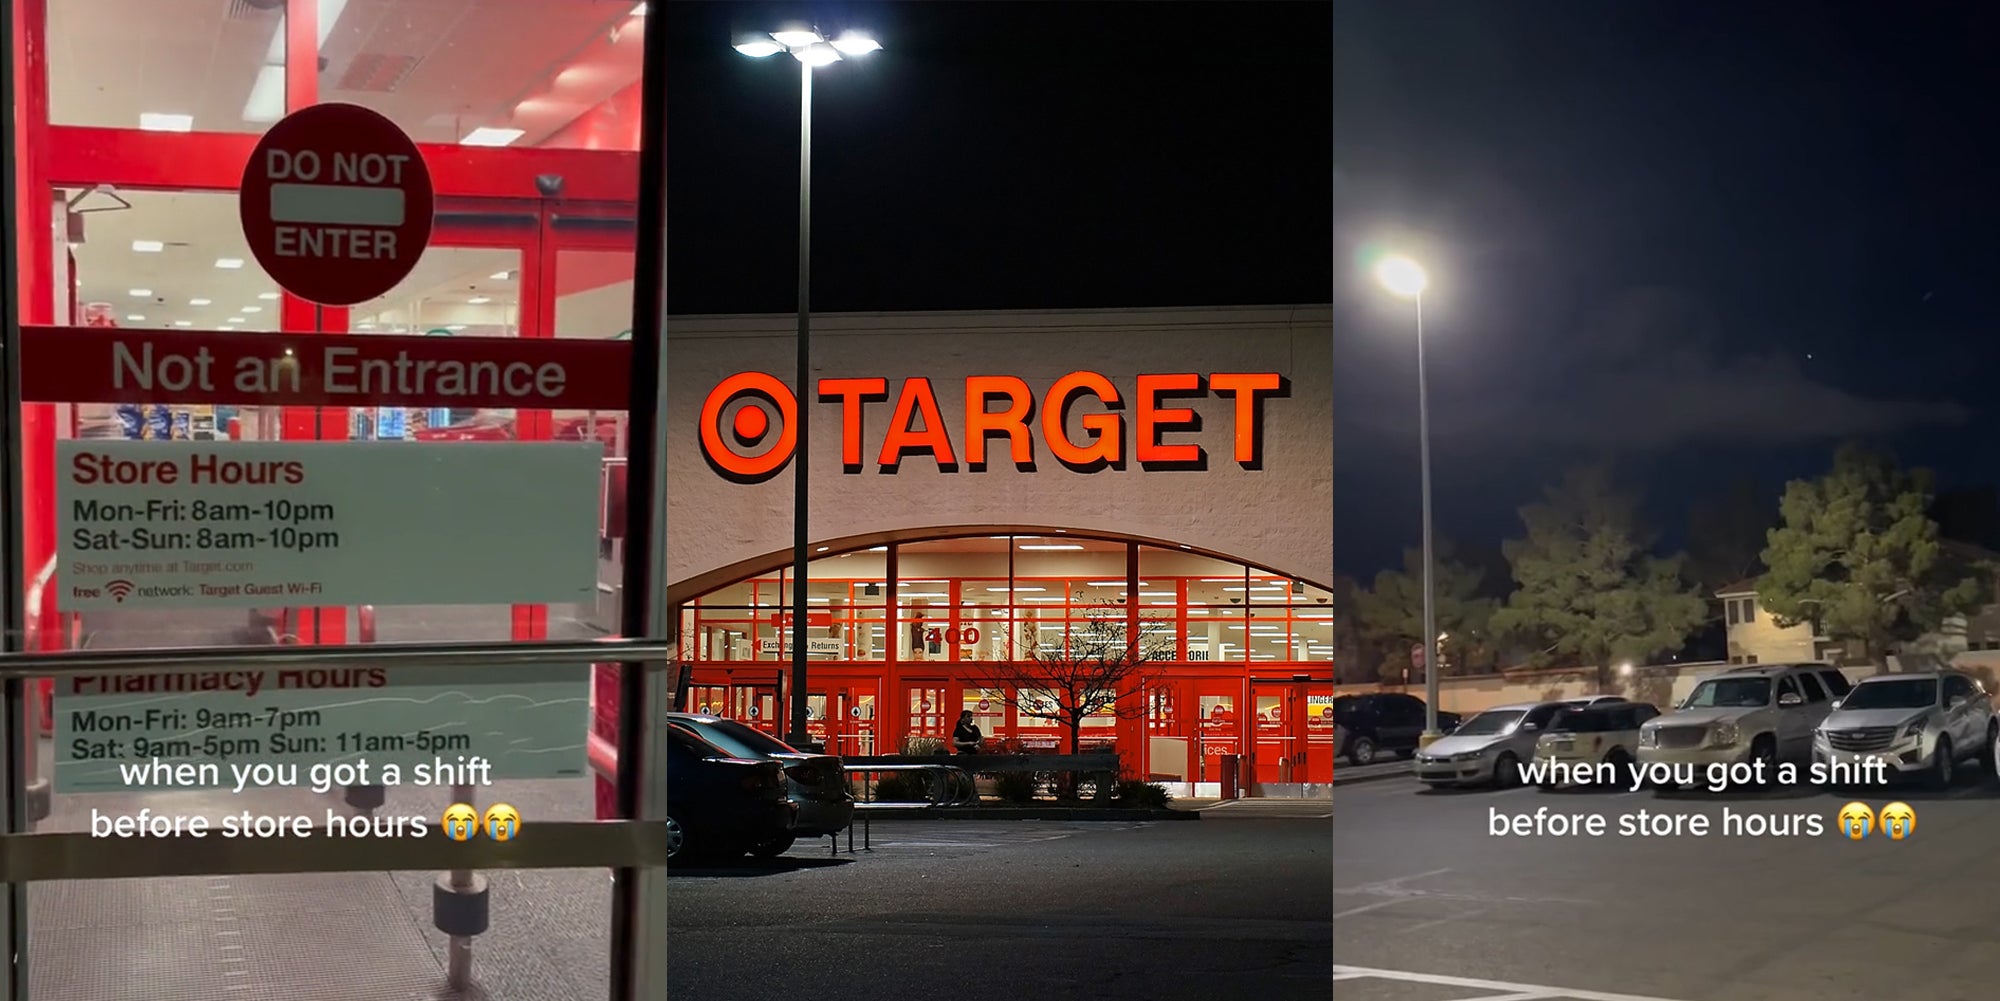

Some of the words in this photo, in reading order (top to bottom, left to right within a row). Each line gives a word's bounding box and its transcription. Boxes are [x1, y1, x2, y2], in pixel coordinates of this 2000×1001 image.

[266, 148, 321, 182] DO
[333, 152, 410, 185] NOT
[274, 228, 398, 260] ENTER
[112, 340, 215, 393] Not
[234, 353, 301, 394] an
[323, 346, 567, 398] Entrance
[817, 370, 1282, 472] TARGET
[72, 453, 179, 486] Store
[190, 453, 305, 486] Hours
[72, 499, 187, 523] Mon-Fri:
[191, 500, 335, 527] 8am-10pm
[72, 527, 193, 552] Sat-Sun:
[195, 528, 340, 555] 8am-10pm
[72, 561, 108, 575] Shop
[112, 561, 162, 575] anytime
[165, 561, 179, 573] at
[183, 560, 254, 573] Target.com
[72, 586, 101, 598] free
[138, 584, 194, 597] network:
[199, 583, 241, 597] Target
[244, 583, 284, 596] Guest
[287, 581, 323, 595] Wi-Fi
[763, 641, 792, 650] Exchng
[811, 642, 839, 650] Returns
[925, 627, 980, 645] 400
[1152, 650, 1209, 661] ACCEORI
[277, 665, 387, 689] Hours
[71, 709, 187, 733] Mon-Fri:
[195, 707, 321, 731] 9am-7pm
[71, 738, 125, 760] Sat:
[133, 735, 260, 760] 9am-5pm
[269, 733, 326, 755] Sun:
[336, 730, 471, 757] 11am-5pm
